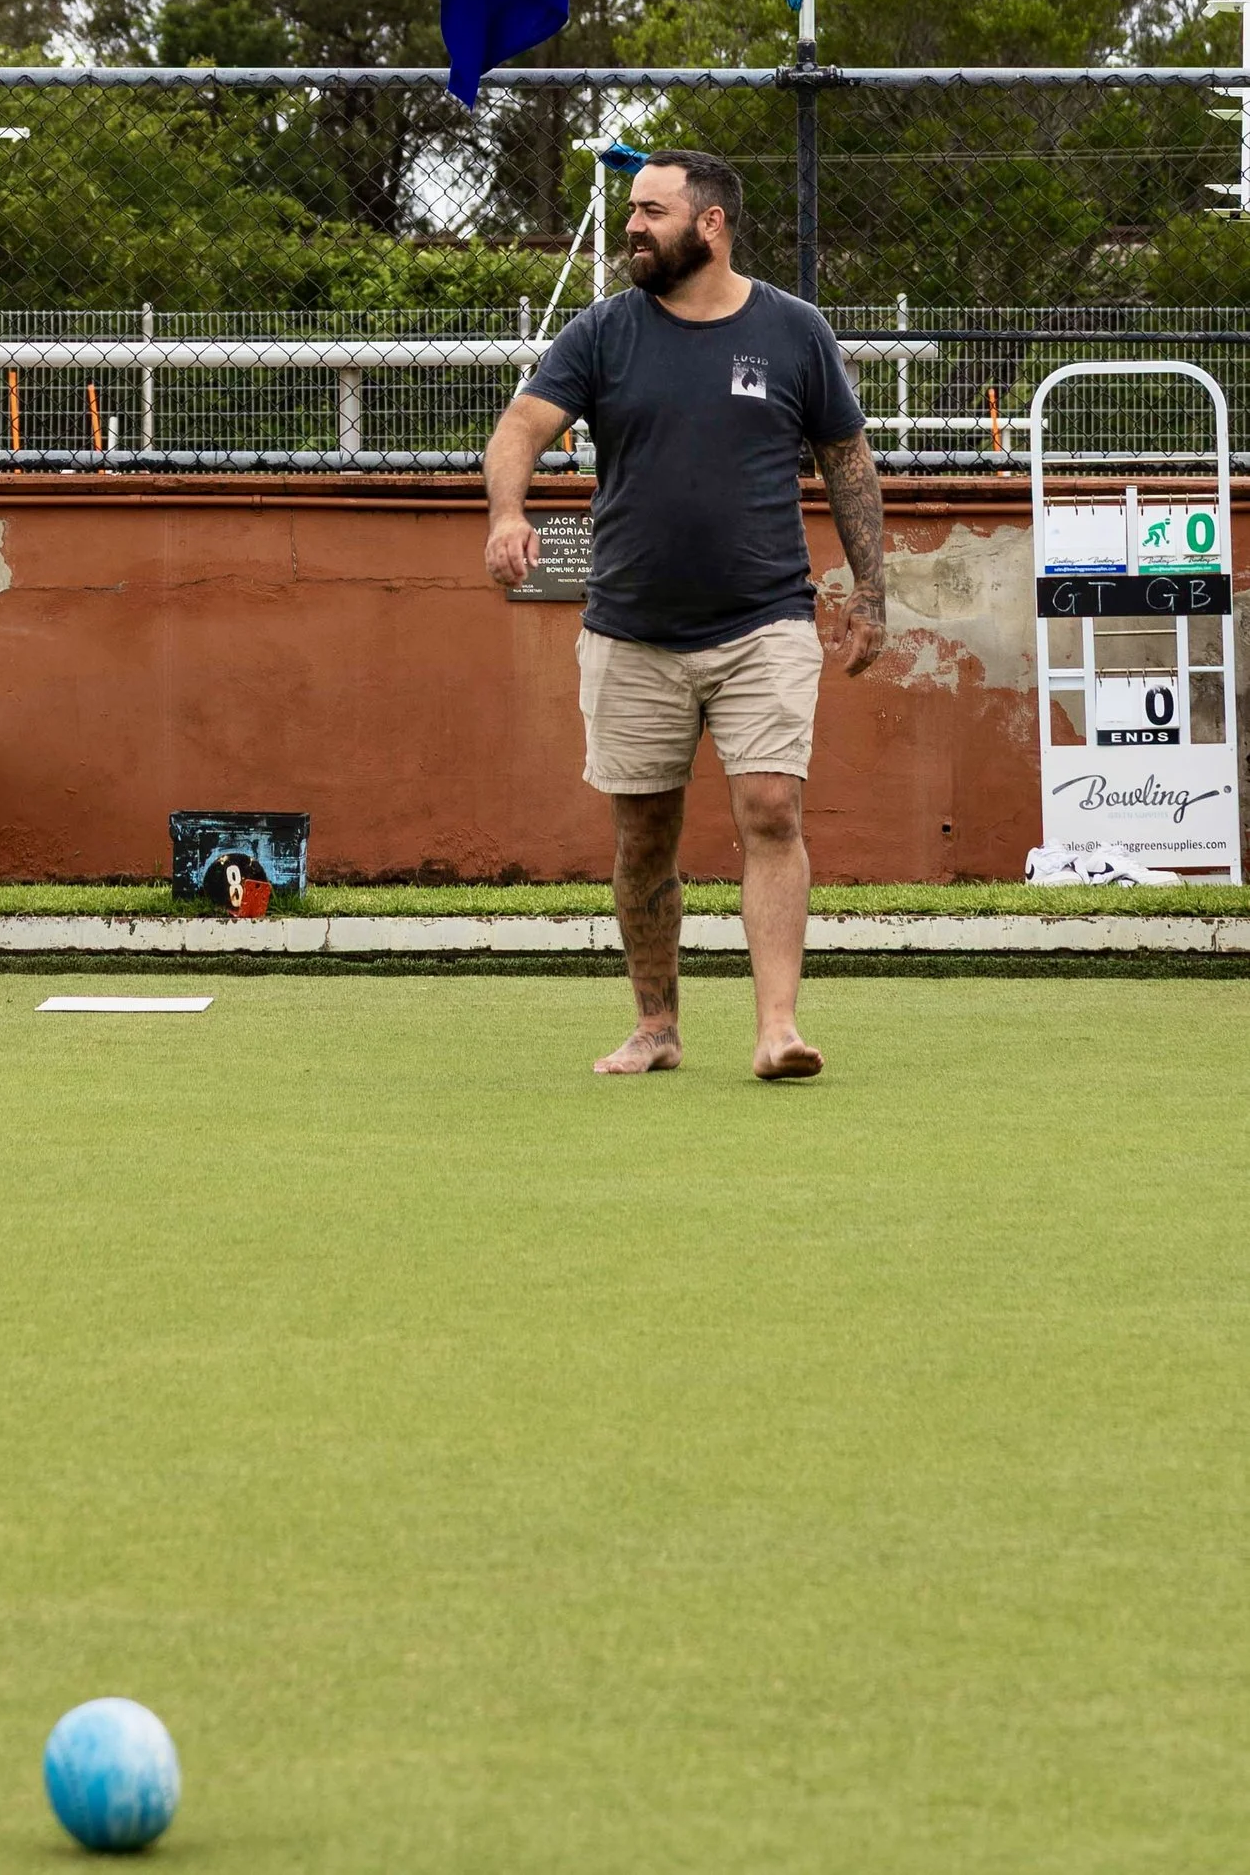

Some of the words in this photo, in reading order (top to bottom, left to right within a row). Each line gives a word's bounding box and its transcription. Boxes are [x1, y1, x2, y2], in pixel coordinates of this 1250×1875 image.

[733, 354, 769, 366] LUCID
[547, 517, 576, 525] JACK
[533, 527, 592, 536] MEMORIAL
[1187, 512, 1215, 554] 0
[567, 557, 588, 565] ROYAL
[1145, 685, 1174, 726] 0
[1111, 732, 1169, 743] ENDS
[1052, 773, 1220, 823] Bowling
